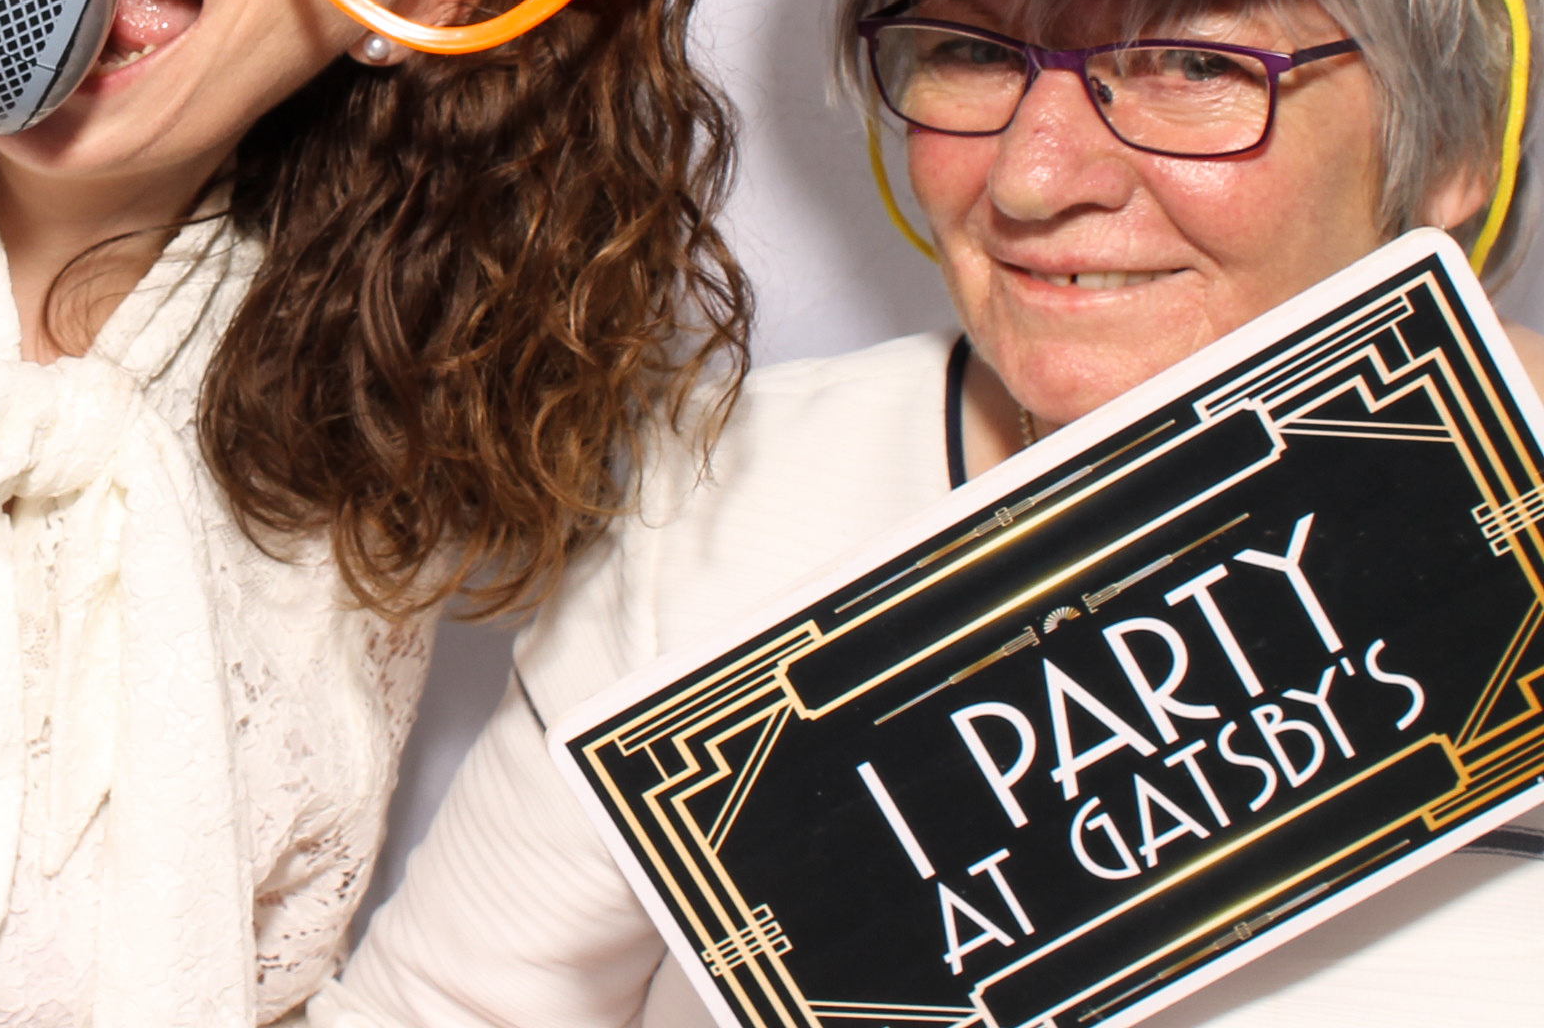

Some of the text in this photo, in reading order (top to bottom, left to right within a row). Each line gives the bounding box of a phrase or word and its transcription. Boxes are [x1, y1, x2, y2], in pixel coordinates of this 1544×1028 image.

[857, 512, 1344, 880] I PARTY
[936, 638, 1425, 976] AT GATSBY'S
